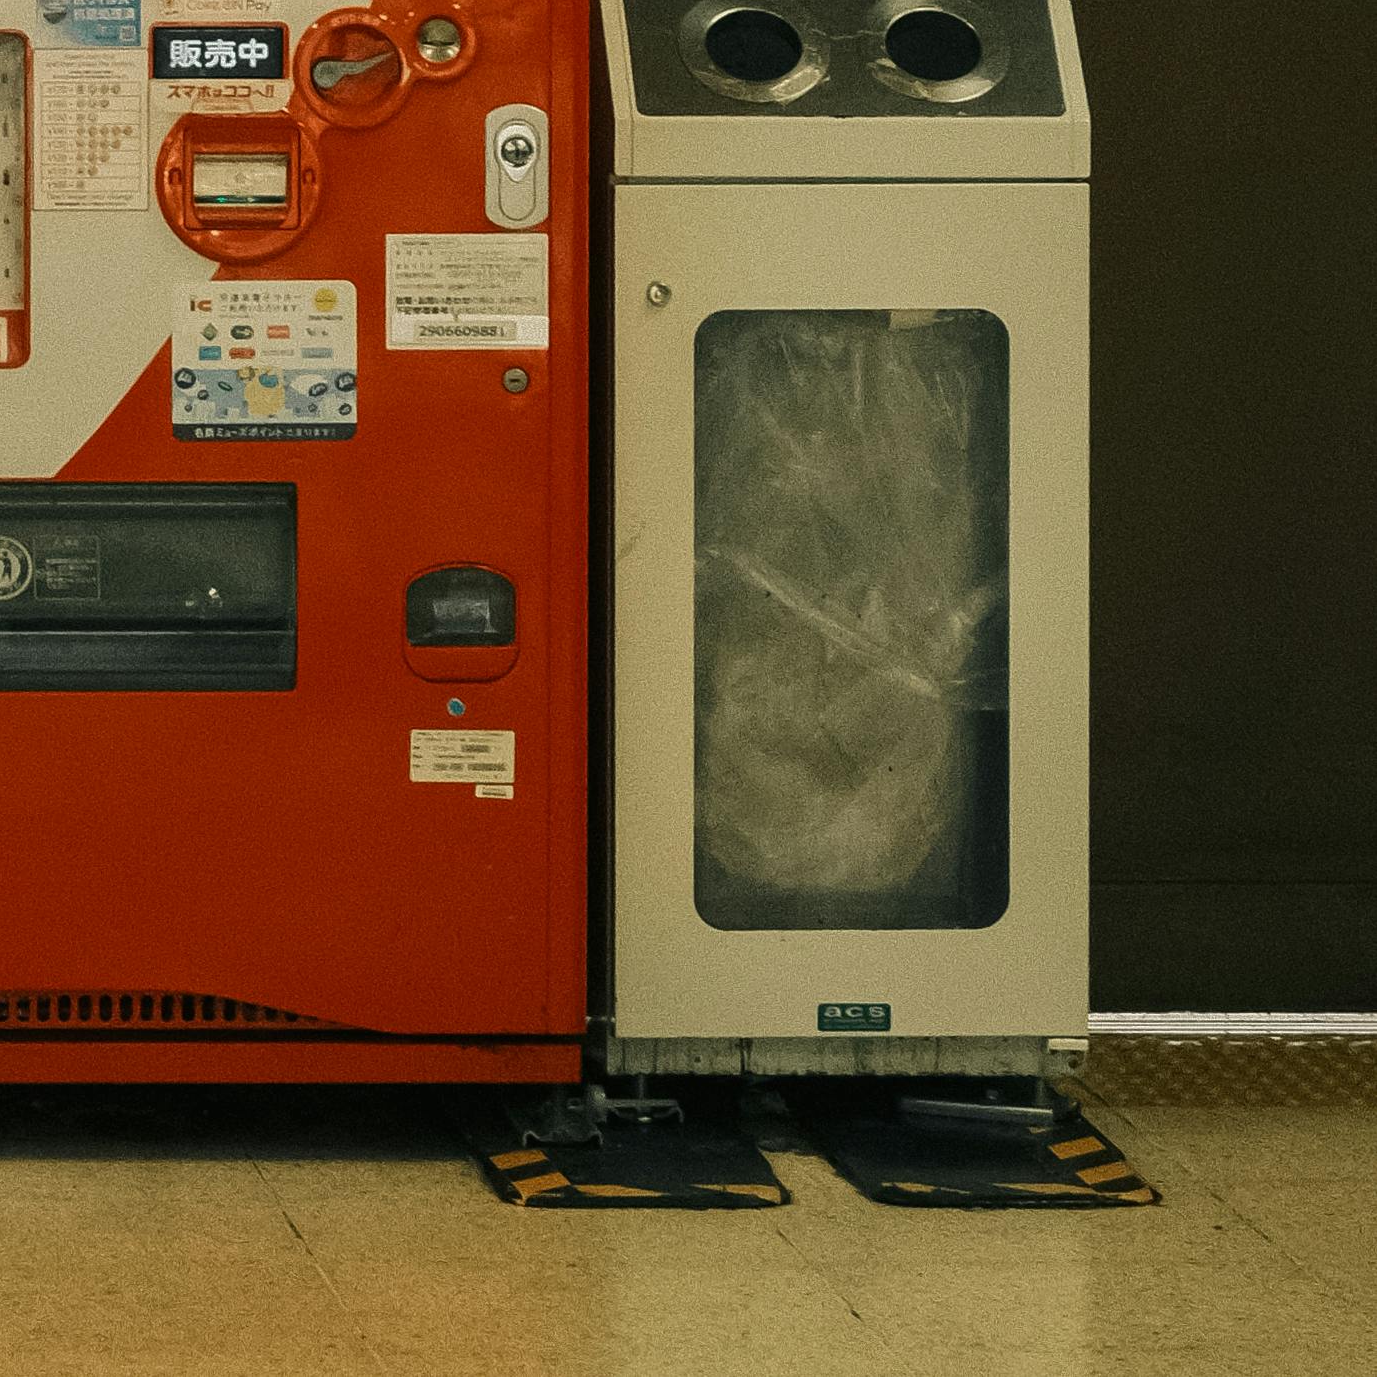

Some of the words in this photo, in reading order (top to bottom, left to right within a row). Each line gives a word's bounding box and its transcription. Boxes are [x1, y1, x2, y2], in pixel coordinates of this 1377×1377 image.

[169, 38, 269, 68] 販売中
[823, 1005, 887, 1019] acs
